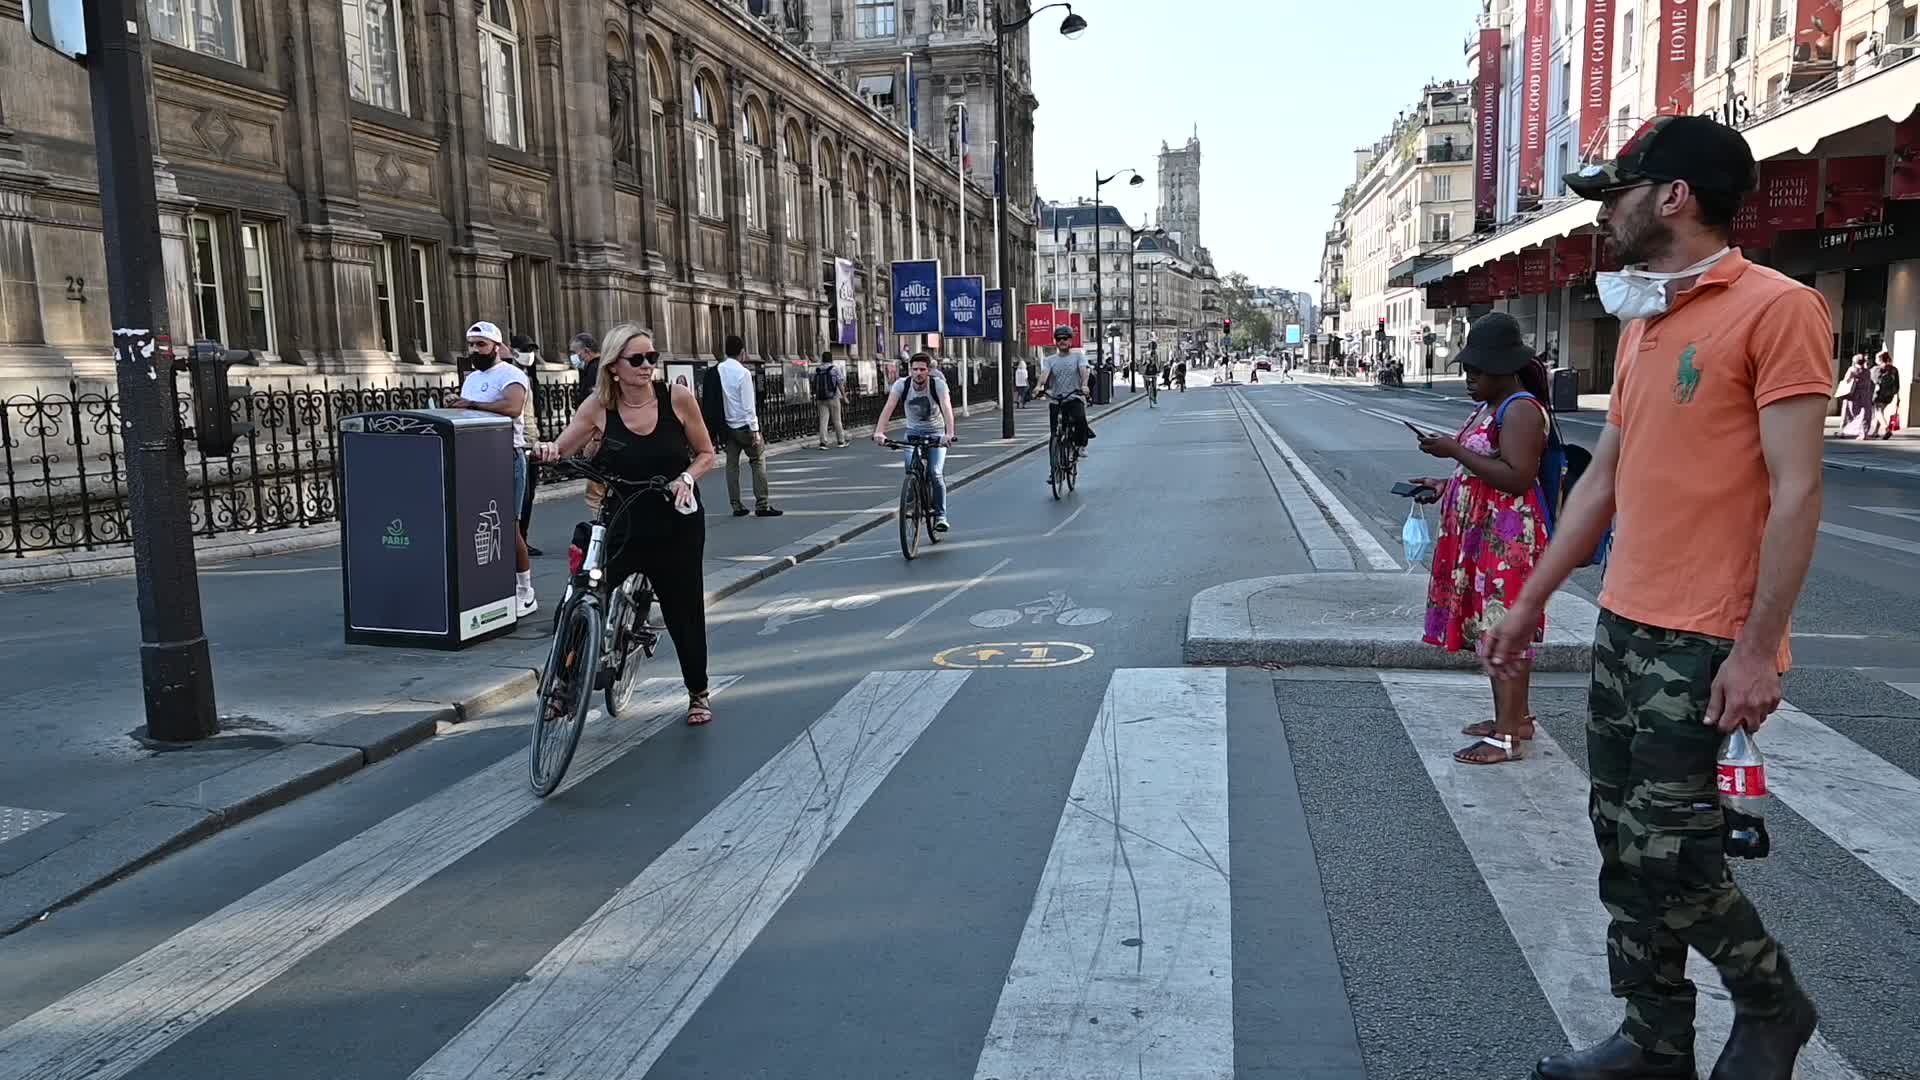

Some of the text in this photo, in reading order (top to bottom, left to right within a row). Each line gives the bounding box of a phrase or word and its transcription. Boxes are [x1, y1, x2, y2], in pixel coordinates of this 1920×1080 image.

[1592, 17, 1606, 62] GOOD
[1670, 8, 1687, 61] HOME
[1528, 34, 1543, 149] HOME GOOD HOME
[1590, 65, 1604, 107] HOME
[1482, 82, 1495, 180] HOME GOOD HOME
[1768, 187, 1808, 198] GOOD
[1768, 197, 1808, 208] HOME
[1856, 223, 1895, 241] MARAIS
[900, 283, 931, 298] RENDEZ
[904, 302, 928, 315] VOUS
[950, 296, 977, 308] RENDEZ
[954, 312, 973, 322] VOUS
[382, 535, 410, 545] PARIS
